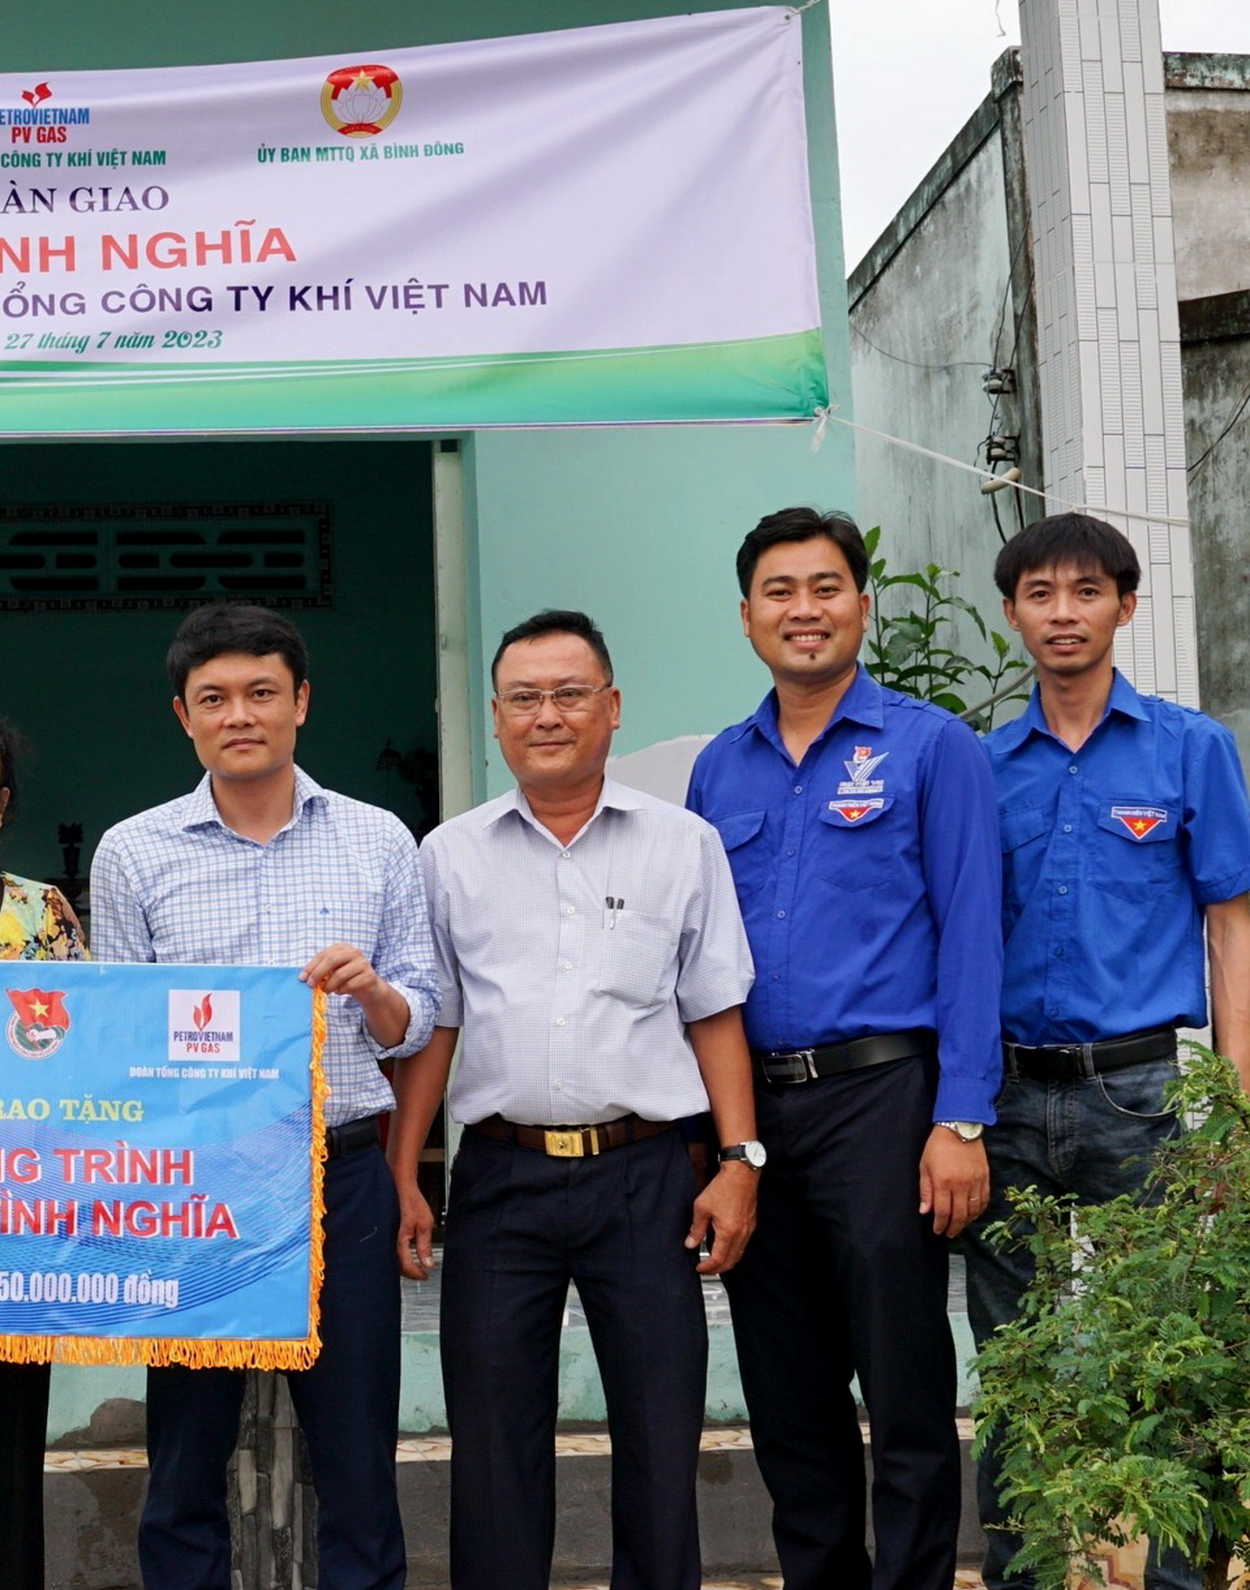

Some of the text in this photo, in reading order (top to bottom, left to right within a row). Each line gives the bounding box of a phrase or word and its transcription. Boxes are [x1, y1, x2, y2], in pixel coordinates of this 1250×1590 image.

[11, 126, 67, 143] PV GAS
[1, 150, 41, 168] CÔNG
[46, 153, 62, 167] TY
[67, 150, 92, 167] KHÍ
[96, 148, 127, 170] VIỆT
[132, 150, 166, 165] NAM
[258, 140, 464, 163] ỦY BAN MTTQ XÃ BÌNH ĐÔNG
[69, 186, 170, 213] GIAO
[102, 219, 297, 271] NGHĨA
[101, 283, 212, 315] CÔNG
[226, 285, 271, 312] TY
[289, 278, 353, 312] KHÍ
[366, 278, 450, 315] VIỆT
[464, 280, 548, 308] NAM
[60, 1094, 144, 1124] TẶNG
[54, 1141, 194, 1186] TRÌNH
[93, 1195, 239, 1240] NGHĨA
[123, 1267, 180, 1308] đồng
